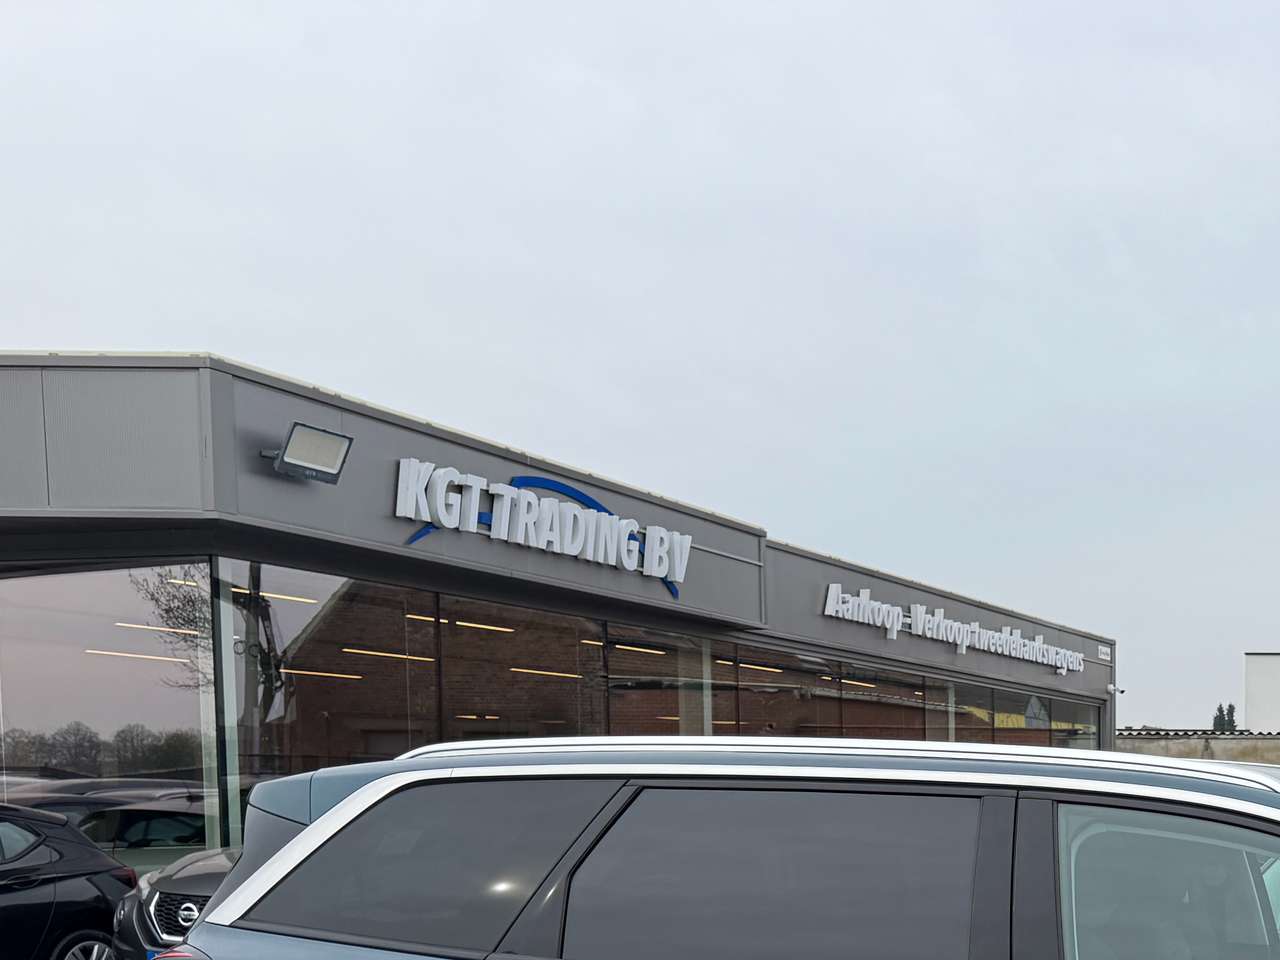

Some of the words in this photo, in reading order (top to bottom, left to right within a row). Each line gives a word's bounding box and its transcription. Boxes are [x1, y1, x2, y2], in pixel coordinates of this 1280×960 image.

[396, 457, 487, 534] KGT
[489, 482, 642, 571] TRADING
[642, 525, 692, 583] BV
